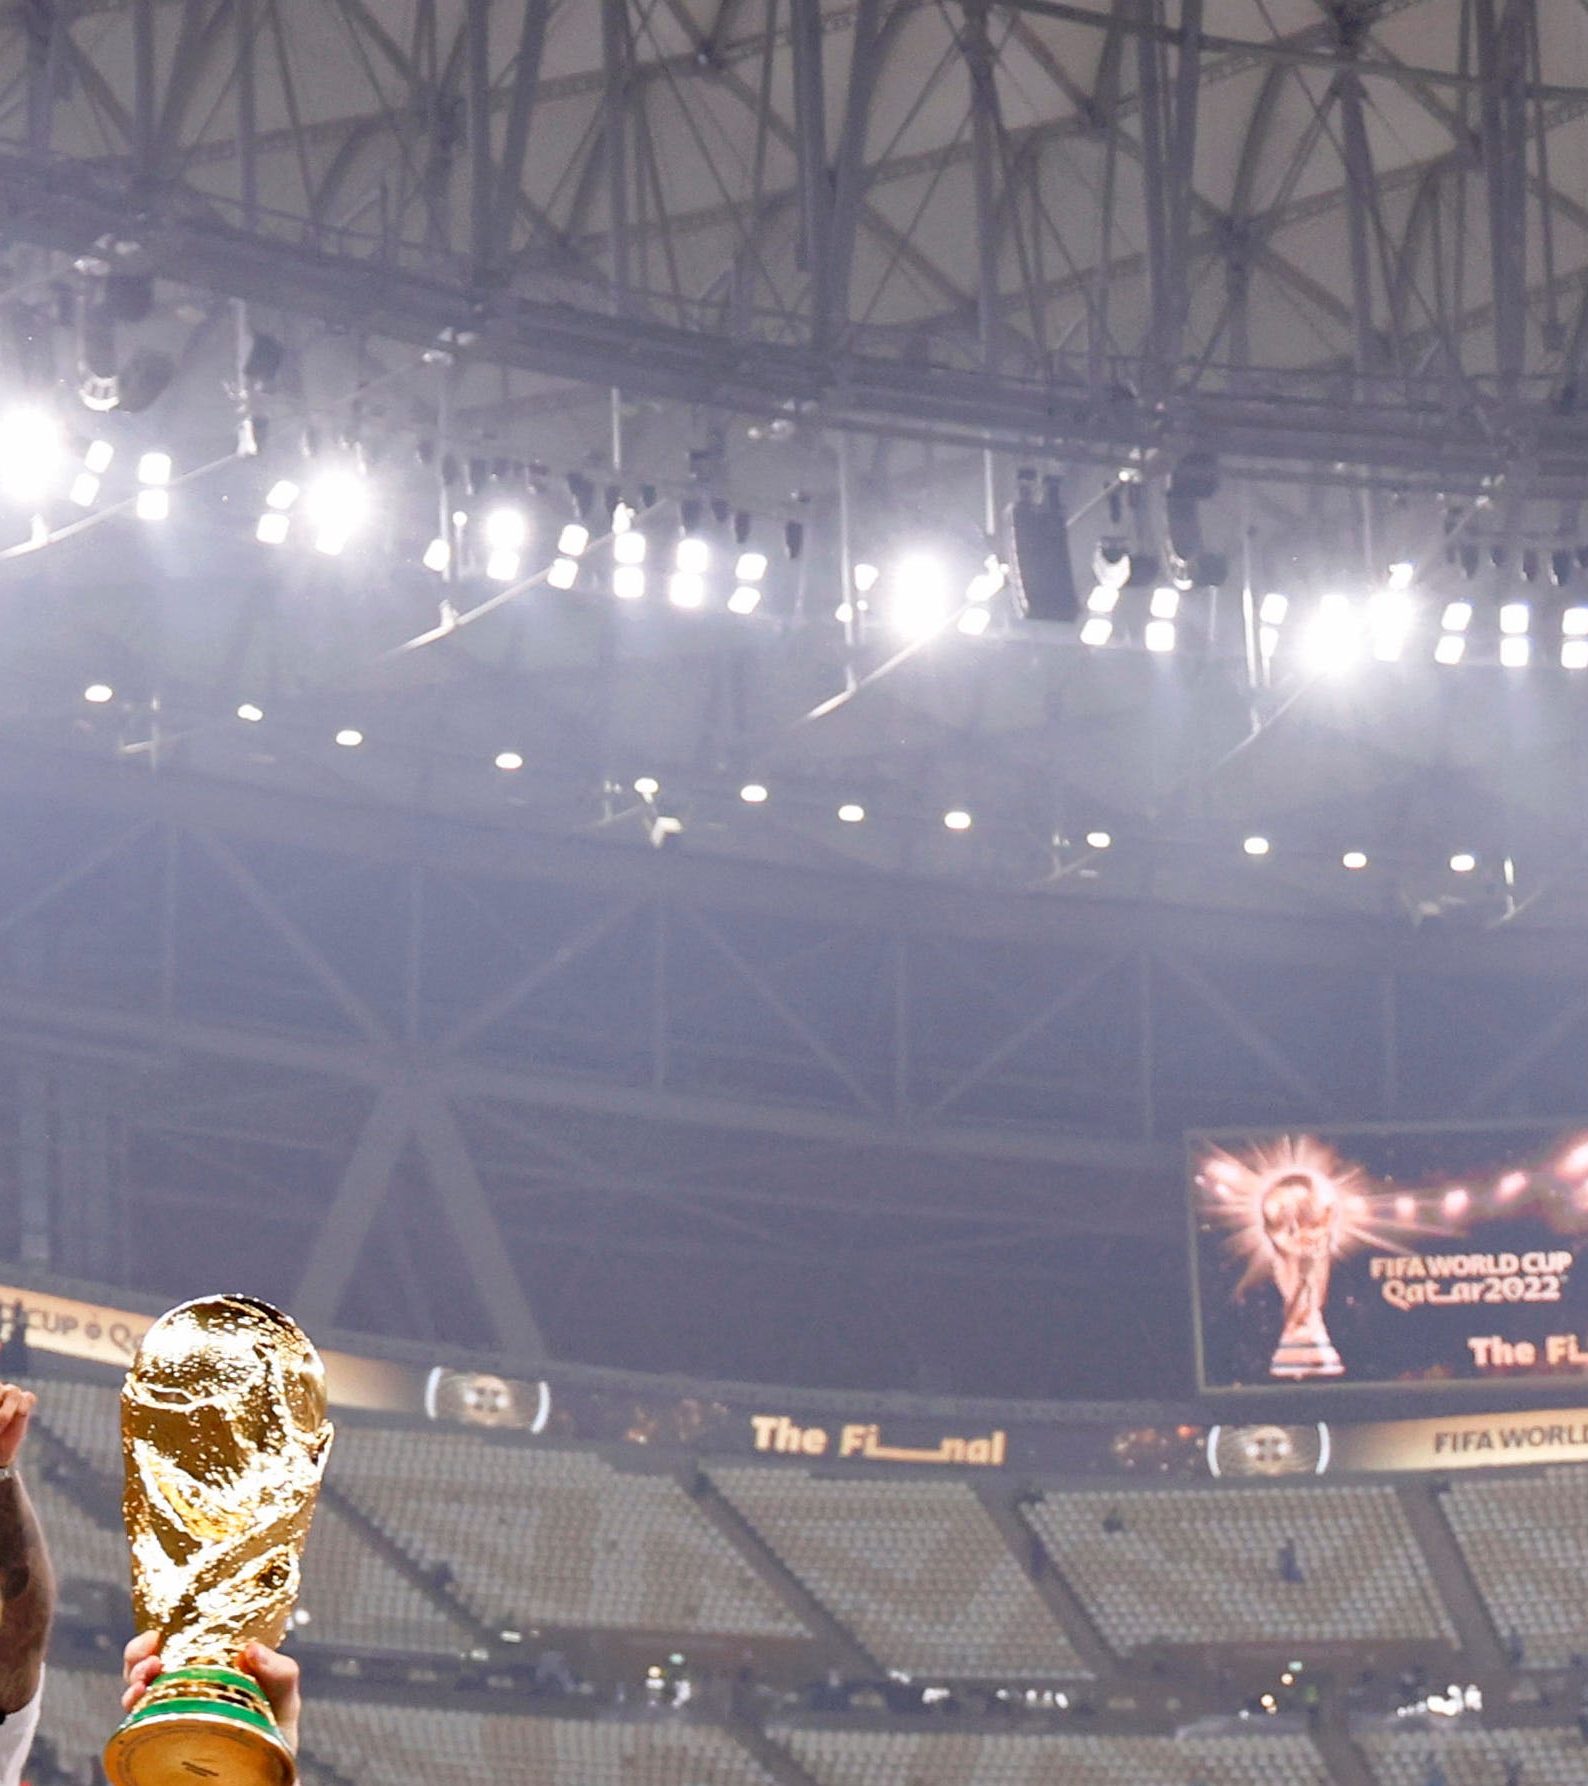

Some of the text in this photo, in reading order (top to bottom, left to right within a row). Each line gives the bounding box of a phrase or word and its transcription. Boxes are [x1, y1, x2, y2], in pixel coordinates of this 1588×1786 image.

[1370, 1251, 1573, 1279] FIFA WORLD CUP
[24, 1308, 80, 1336] CUP
[1468, 1335, 1536, 1367] The
[751, 1415, 828, 1455] The
[1434, 1431, 1493, 1455] FIFA
